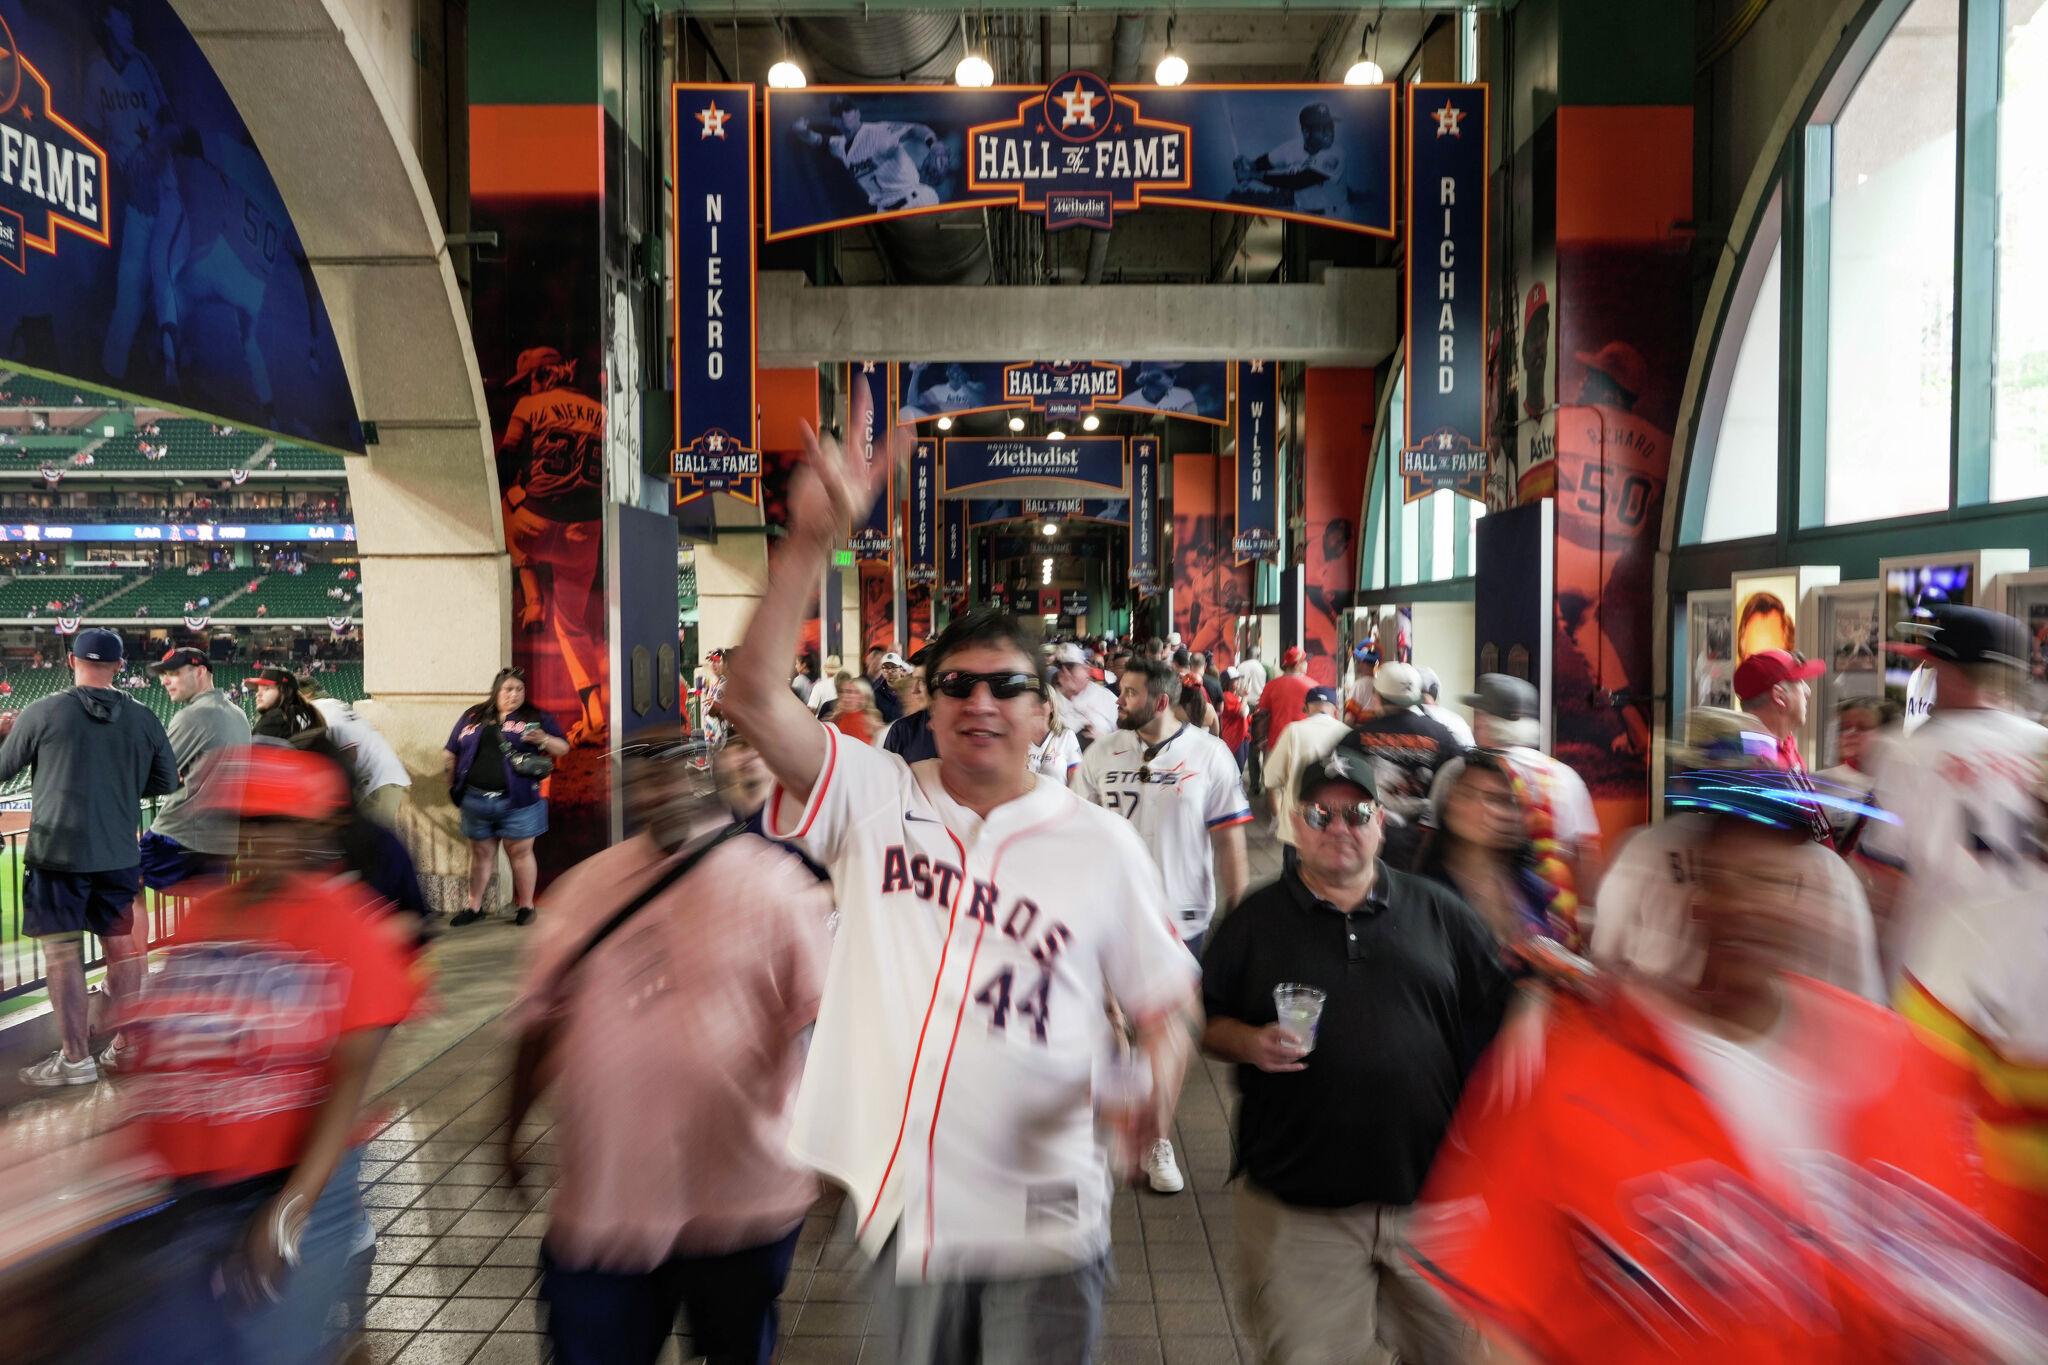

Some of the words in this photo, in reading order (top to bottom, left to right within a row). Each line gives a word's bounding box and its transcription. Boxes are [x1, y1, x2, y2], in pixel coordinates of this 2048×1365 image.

[0, 122, 98, 223] FAME
[979, 135, 1057, 179] HALL
[1095, 133, 1180, 179] FAME
[706, 193, 723, 381] NIEKRO
[1438, 176, 1455, 394] RICHARD
[1009, 370, 1052, 395] HALL
[1071, 370, 1117, 395] FAME
[675, 454, 708, 473] HALL
[722, 454, 758, 473] FAME
[987, 443, 1024, 451] HOUSTON
[987, 446, 1079, 467] Methodist
[1250, 401, 1263, 501] WILSON
[1404, 452, 1438, 472] HALL
[1451, 452, 1487, 472] FAME
[1025, 498, 1047, 512] HALL
[1057, 498, 1081, 512] FAME
[1577, 462, 1652, 527] 50
[835, 551, 853, 565] EXIT
[848, 538, 865, 550] HALL
[872, 538, 892, 550] FAME
[882, 844, 1075, 961] ASTROS
[974, 965, 1057, 1046] 44
